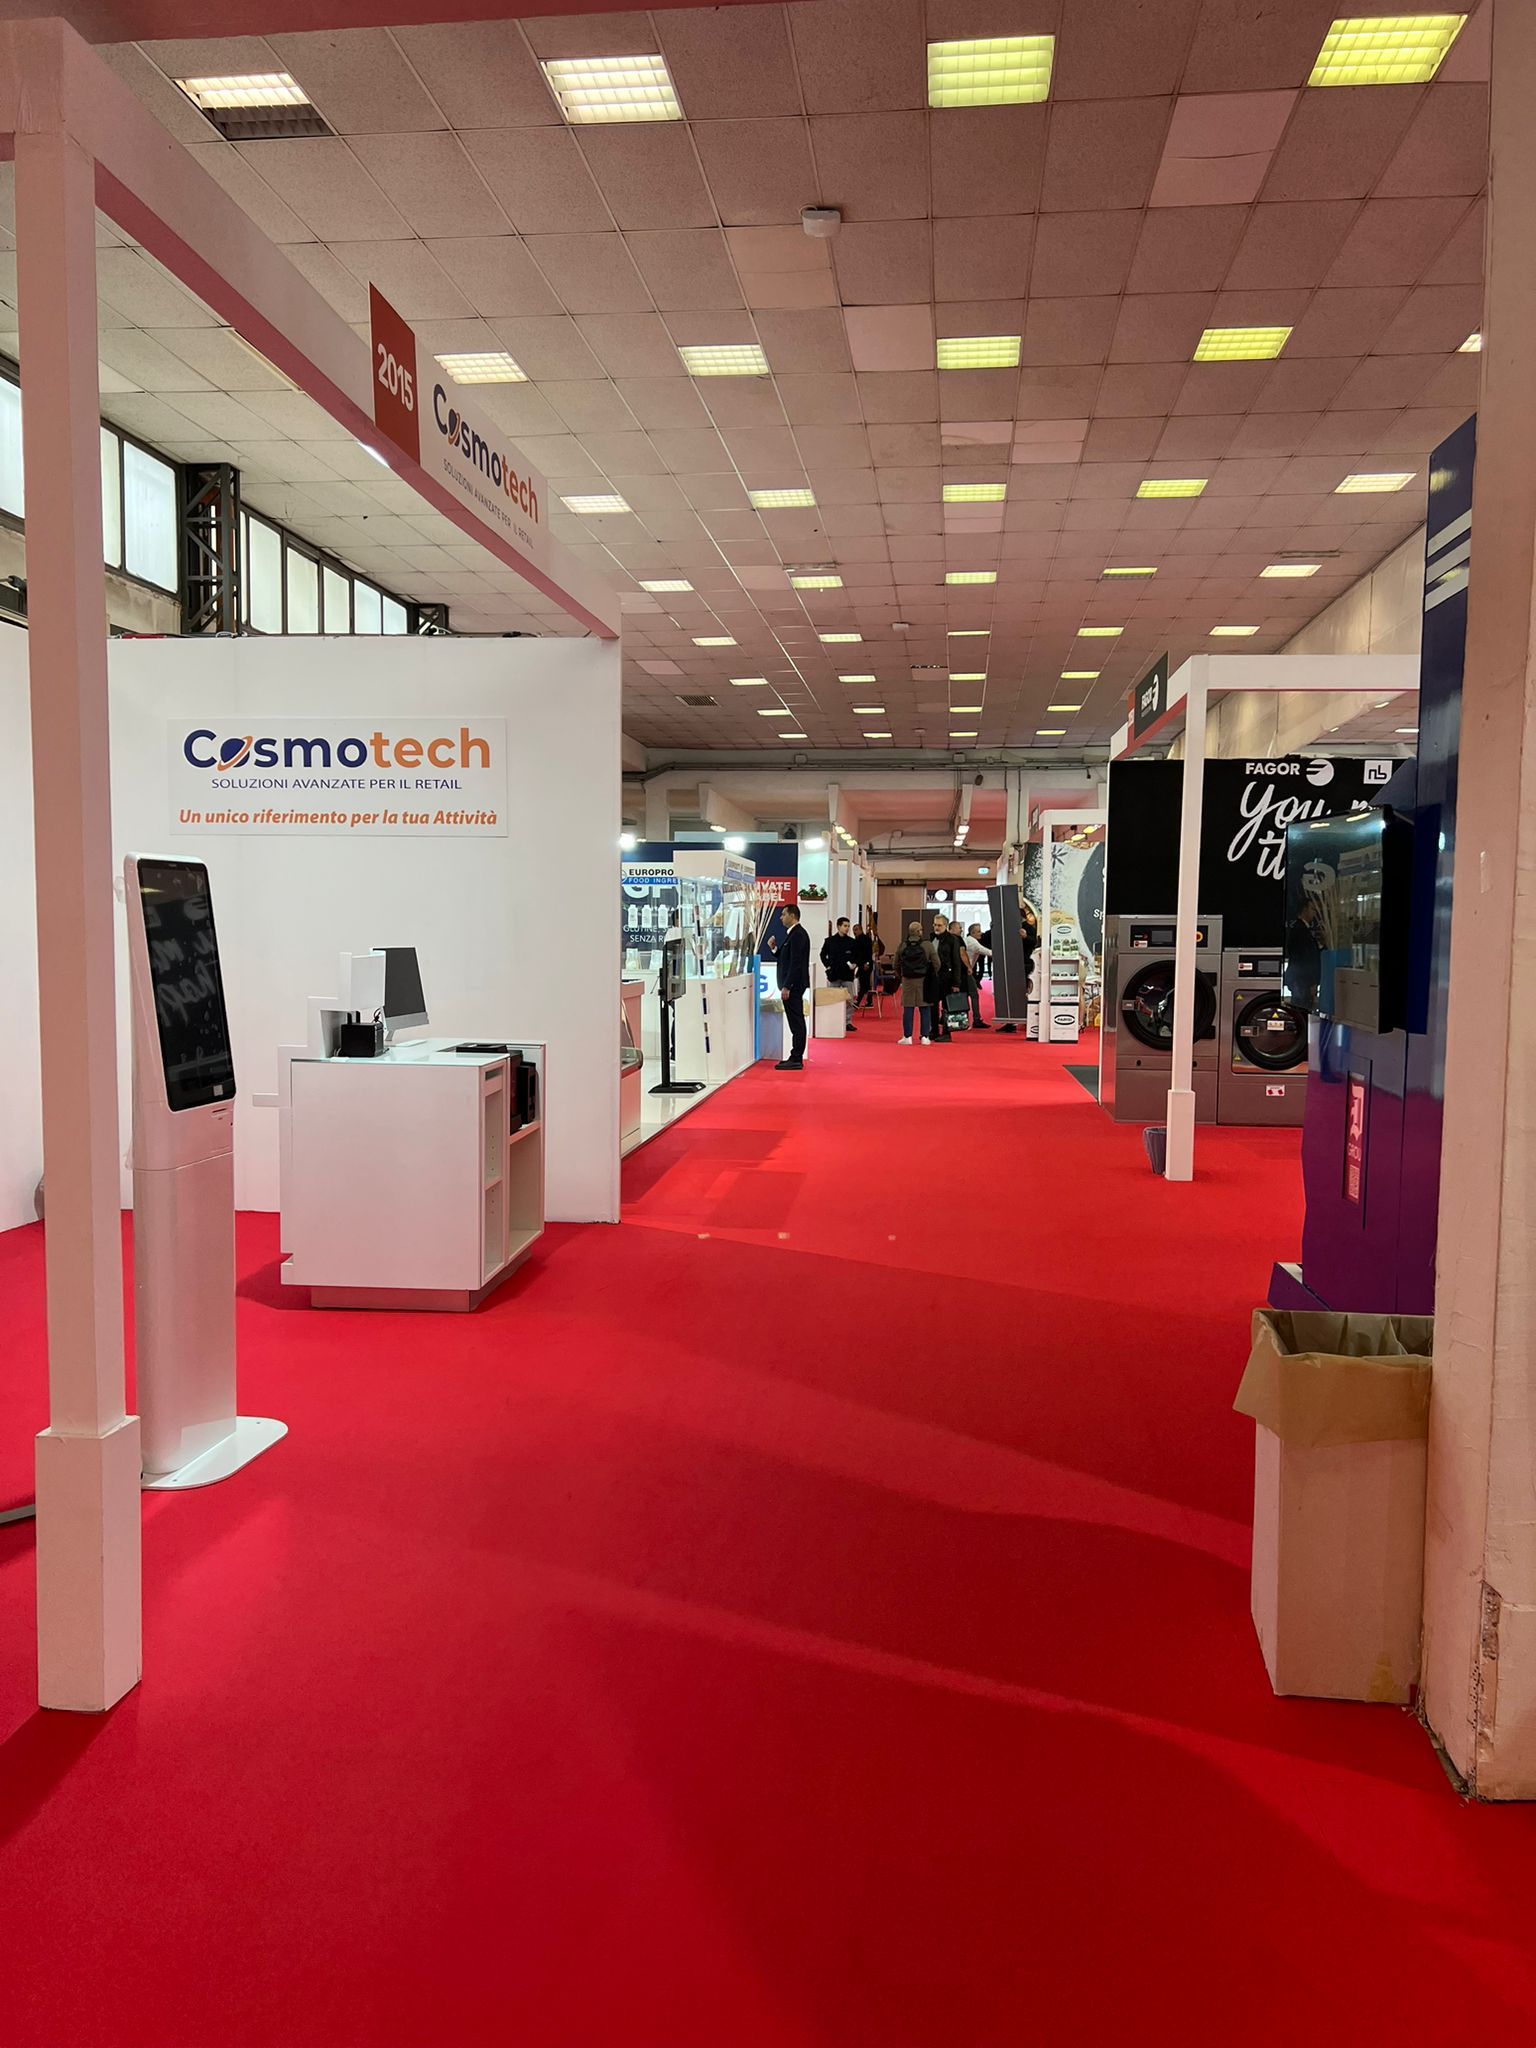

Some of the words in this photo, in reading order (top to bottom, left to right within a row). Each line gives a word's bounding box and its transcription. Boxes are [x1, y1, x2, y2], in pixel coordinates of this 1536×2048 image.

[378, 343, 414, 412] 2015
[433, 383, 538, 524] Cosmotech
[443, 458, 474, 495] SOLUZIONI
[474, 488, 501, 520] AVANZATE
[183, 727, 490, 772] Cosmotech
[211, 778, 288, 789] SOLUZIONI
[292, 778, 366, 789] AVANZATE
[369, 779, 396, 789] PER
[399, 779, 411, 789] IL
[415, 779, 462, 790] RETAIL
[1245, 762, 1300, 776] FAGOR
[179, 808, 201, 824] Un
[205, 808, 249, 824] unico
[253, 808, 347, 825] riferimento
[350, 812, 380, 828] per
[382, 809, 399, 825] la
[402, 811, 429, 825] tua
[433, 809, 497, 825] Attività
[629, 934, 657, 943] SENZA
